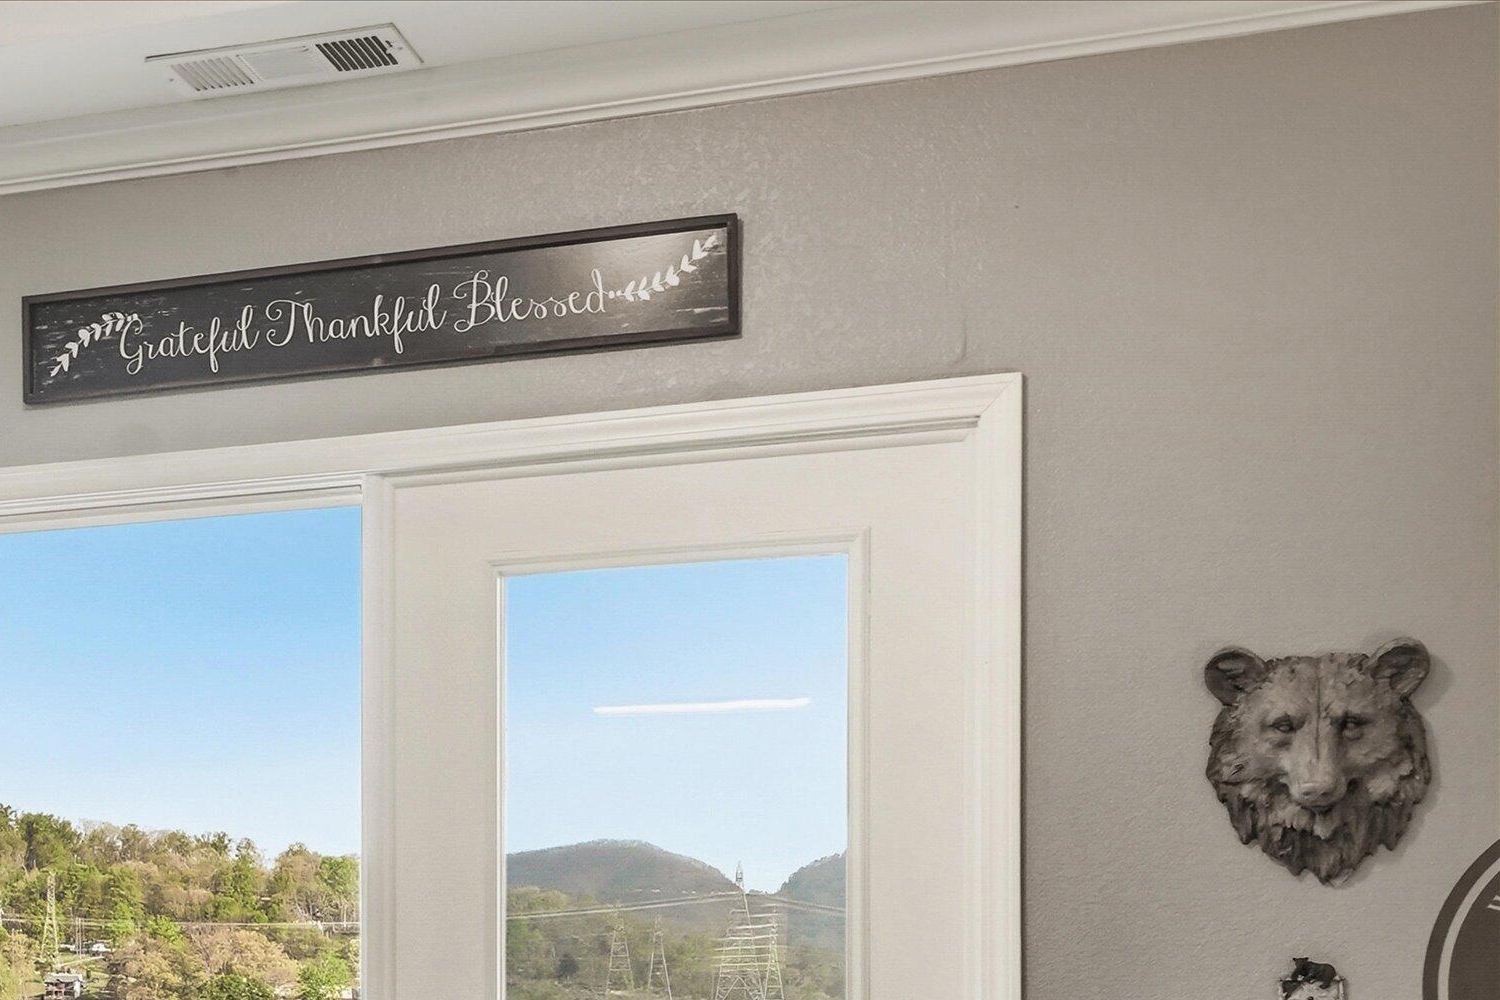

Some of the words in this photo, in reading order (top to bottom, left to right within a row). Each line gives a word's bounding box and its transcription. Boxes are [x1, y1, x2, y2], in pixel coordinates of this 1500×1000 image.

[119, 304, 260, 375] Grateful
[266, 283, 447, 354] Thankful
[453, 268, 607, 333] Blessed
